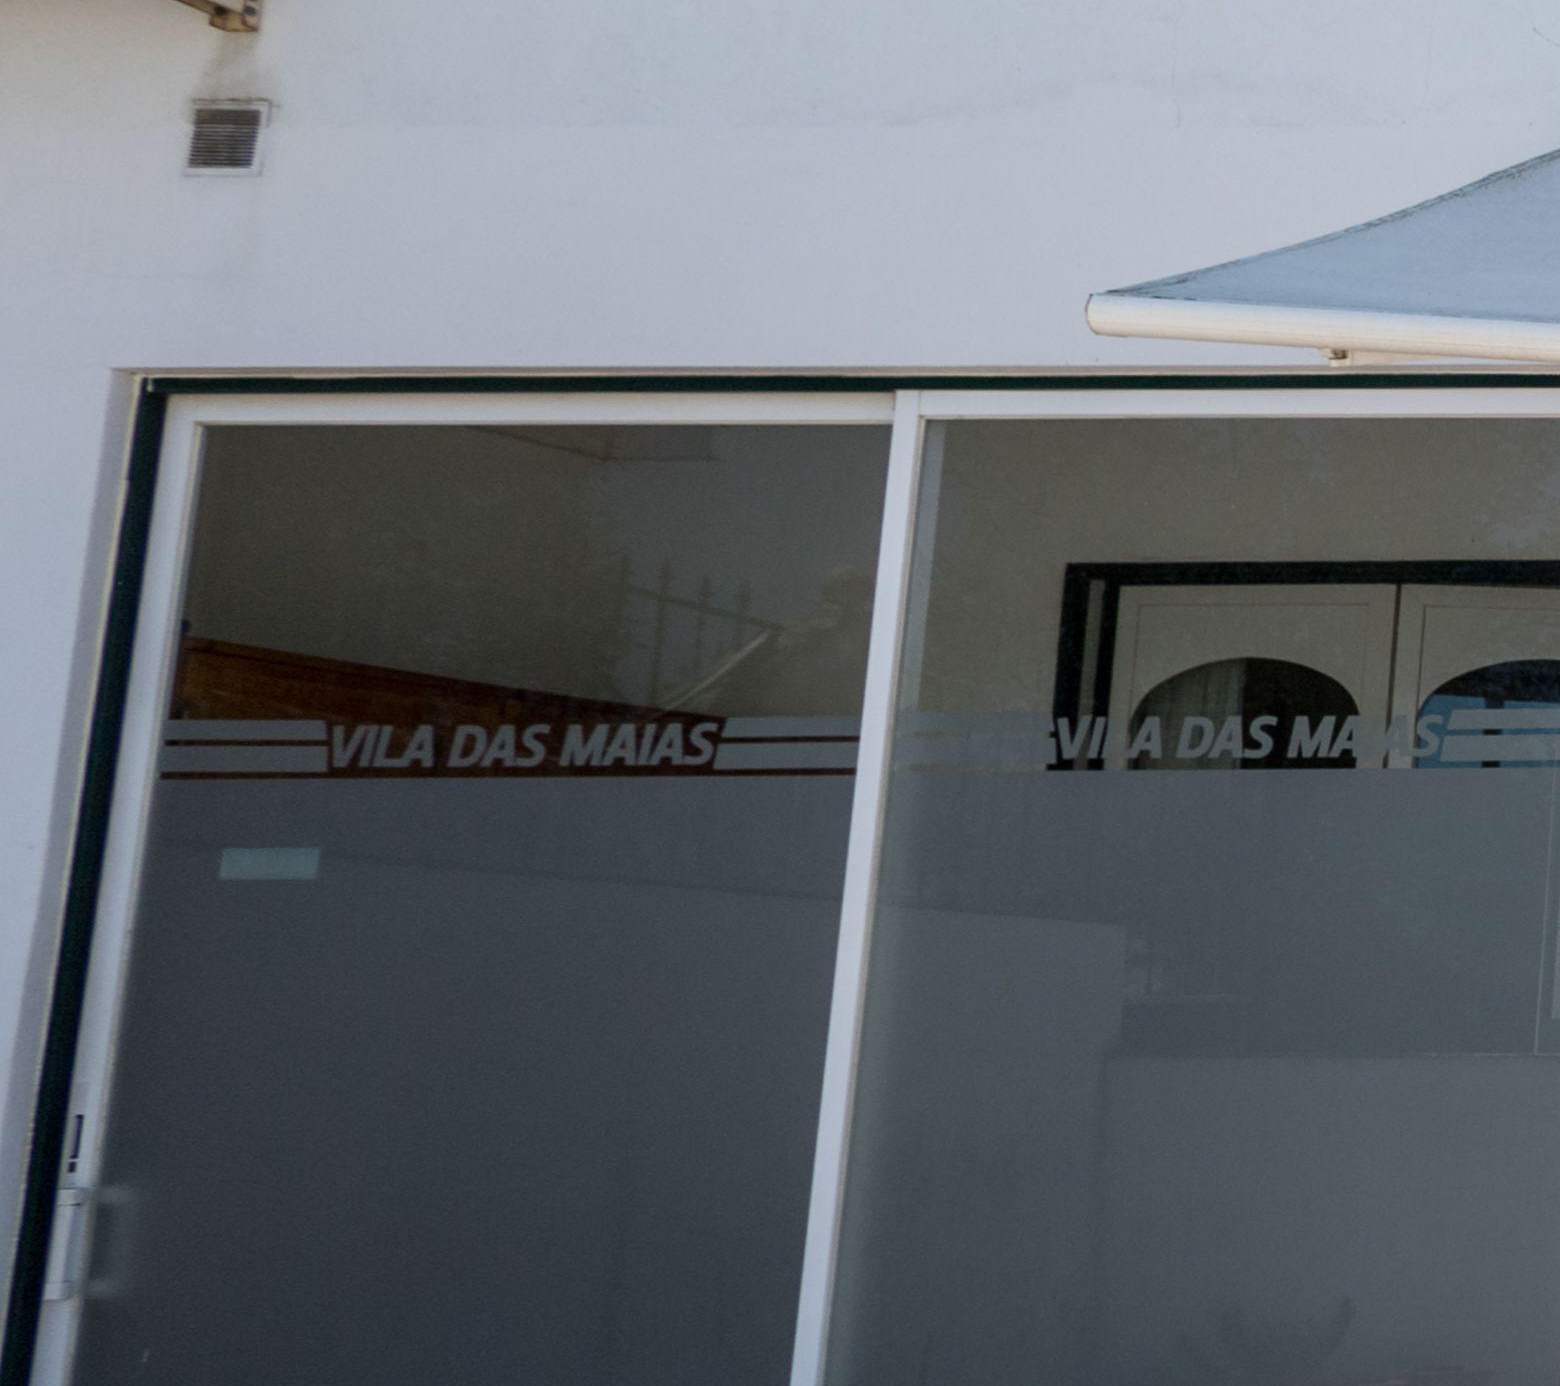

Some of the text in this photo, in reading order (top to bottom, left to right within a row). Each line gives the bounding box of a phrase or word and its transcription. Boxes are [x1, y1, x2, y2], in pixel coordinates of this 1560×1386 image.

[329, 722, 718, 769] VILA DAS MAIAS
[1055, 714, 1442, 761] VIA DAS MAAS
